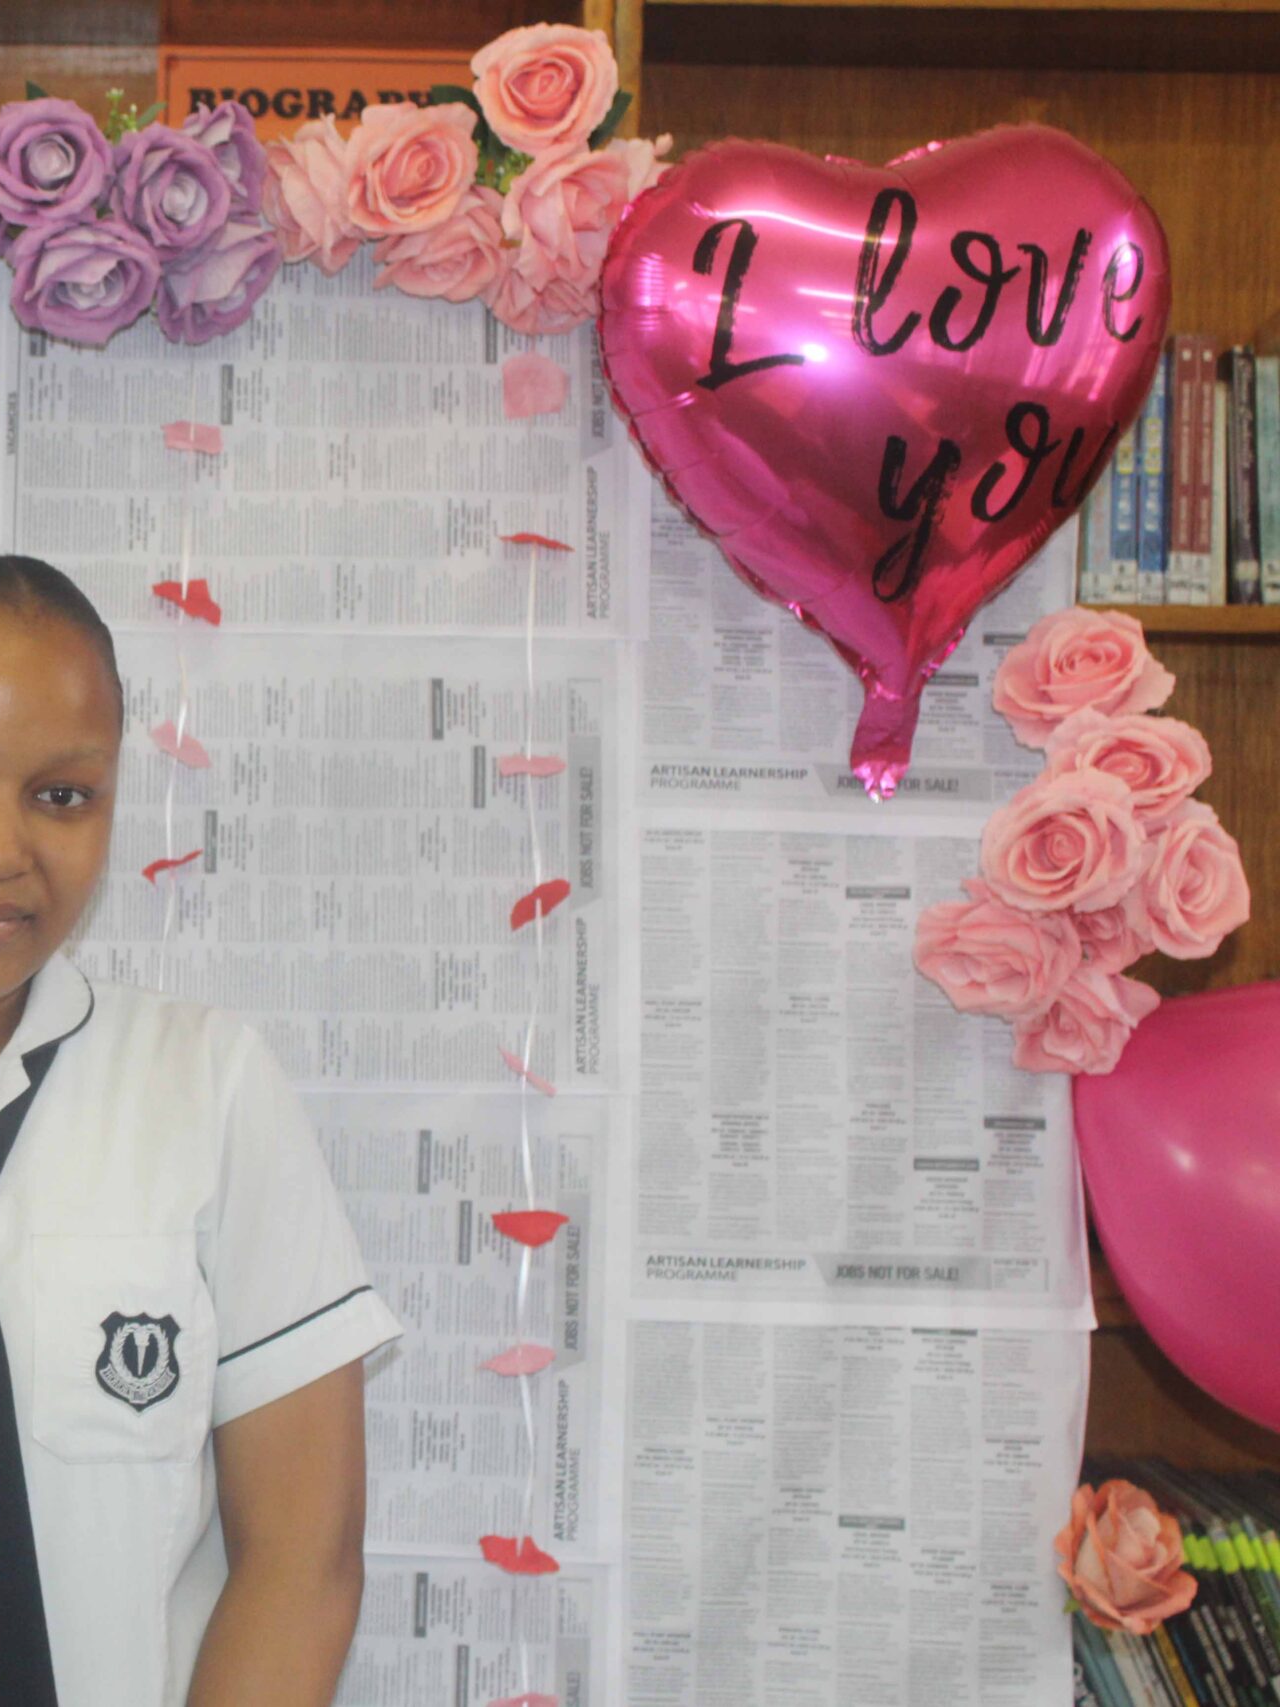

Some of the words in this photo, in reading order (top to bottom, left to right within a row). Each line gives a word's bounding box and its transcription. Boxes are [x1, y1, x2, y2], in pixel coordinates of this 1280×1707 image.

[851, 188, 1144, 356] love
[587, 466, 599, 557] LEARNERSHIP
[872, 402, 1122, 601] you
[586, 559, 597, 619] ARTISAN
[599, 531, 611, 619] PROGRAMME
[650, 778, 741, 791] PROGRAMME
[651, 765, 711, 778] ARTISAN
[713, 767, 808, 780] LEARNERSHIP
[924, 778, 958, 793] SALE!
[580, 800, 593, 826] FOR
[580, 829, 593, 855] NOT
[581, 857, 594, 888] JOBS
[576, 918, 588, 1011] LEARNERSHIP
[576, 1013, 587, 1074] ARTISAN
[588, 983, 600, 1074] PROGRAMME
[566, 1257, 579, 1283] FOR
[647, 1255, 707, 1268] ARTISAN
[709, 1257, 807, 1271] LEARNERSHIP
[836, 1264, 865, 1278] JOBS
[868, 1265, 893, 1279] NOT
[897, 1265, 920, 1280] FOR
[923, 1266, 959, 1281] SALE!
[647, 1268, 737, 1281] PROGRAMME
[565, 1285, 578, 1313] NOT
[564, 1315, 577, 1349] JOBS
[556, 1379, 570, 1476] LEARNERSHIP
[554, 1477, 567, 1542] ARTISAN
[567, 1448, 581, 1542] PROGRAMME
